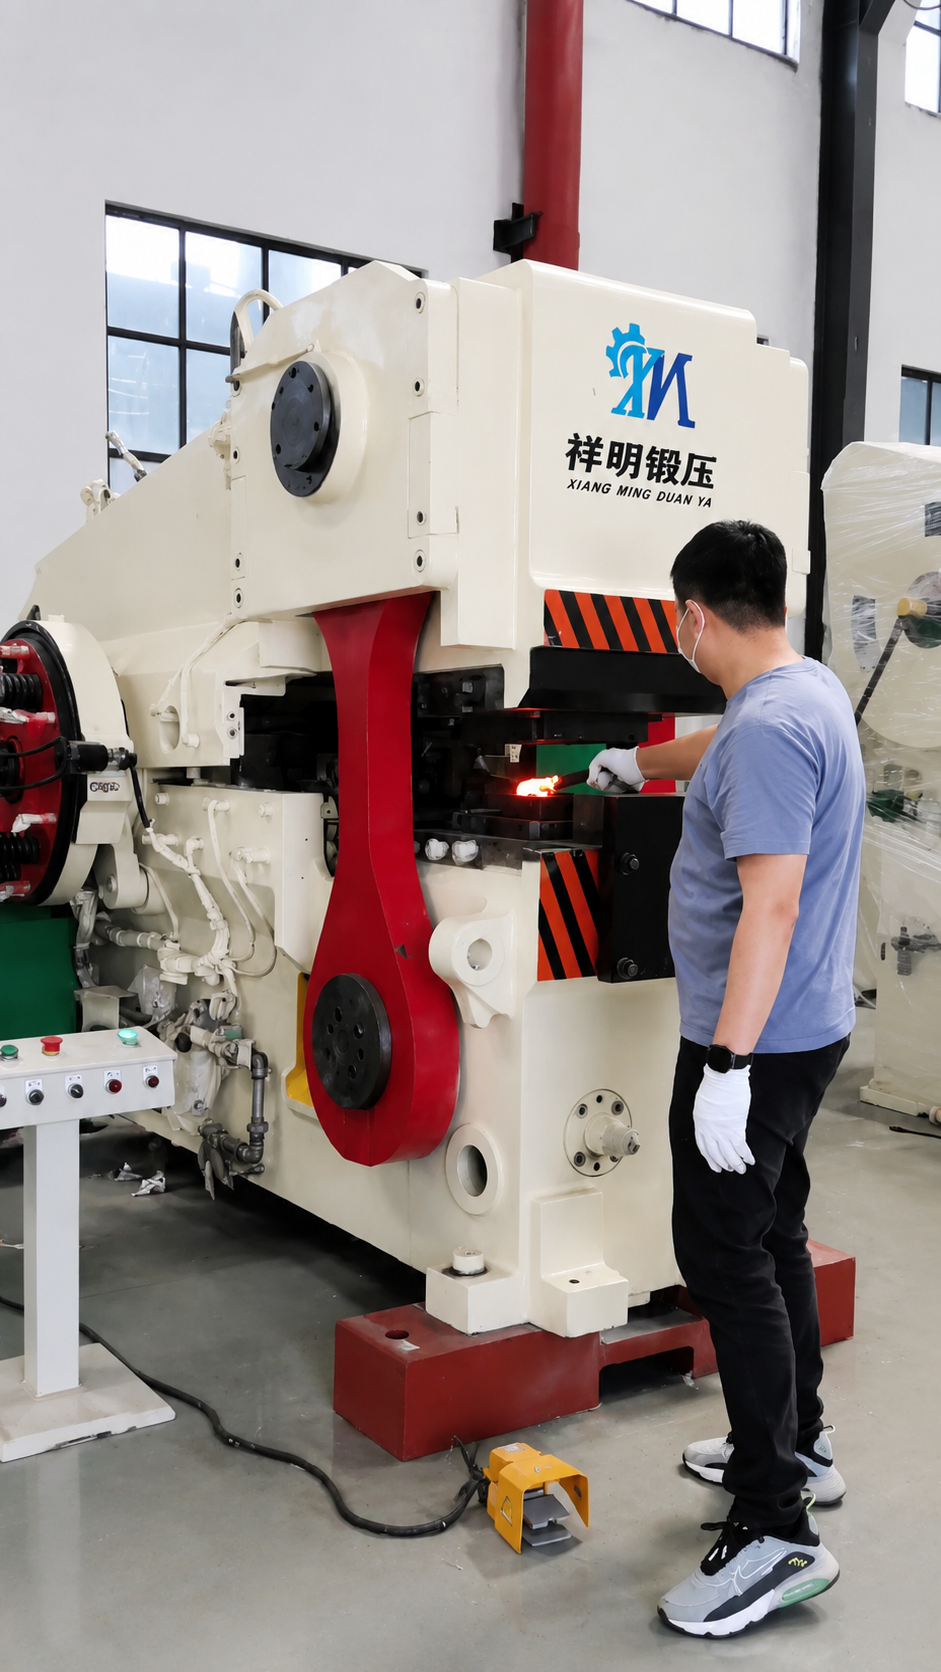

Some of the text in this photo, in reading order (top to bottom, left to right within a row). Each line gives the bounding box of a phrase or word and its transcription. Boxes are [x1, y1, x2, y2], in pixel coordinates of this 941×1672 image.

[565, 432, 718, 490] 祥明锻压
[567, 478, 712, 508] XIANG MING DUAN YA
